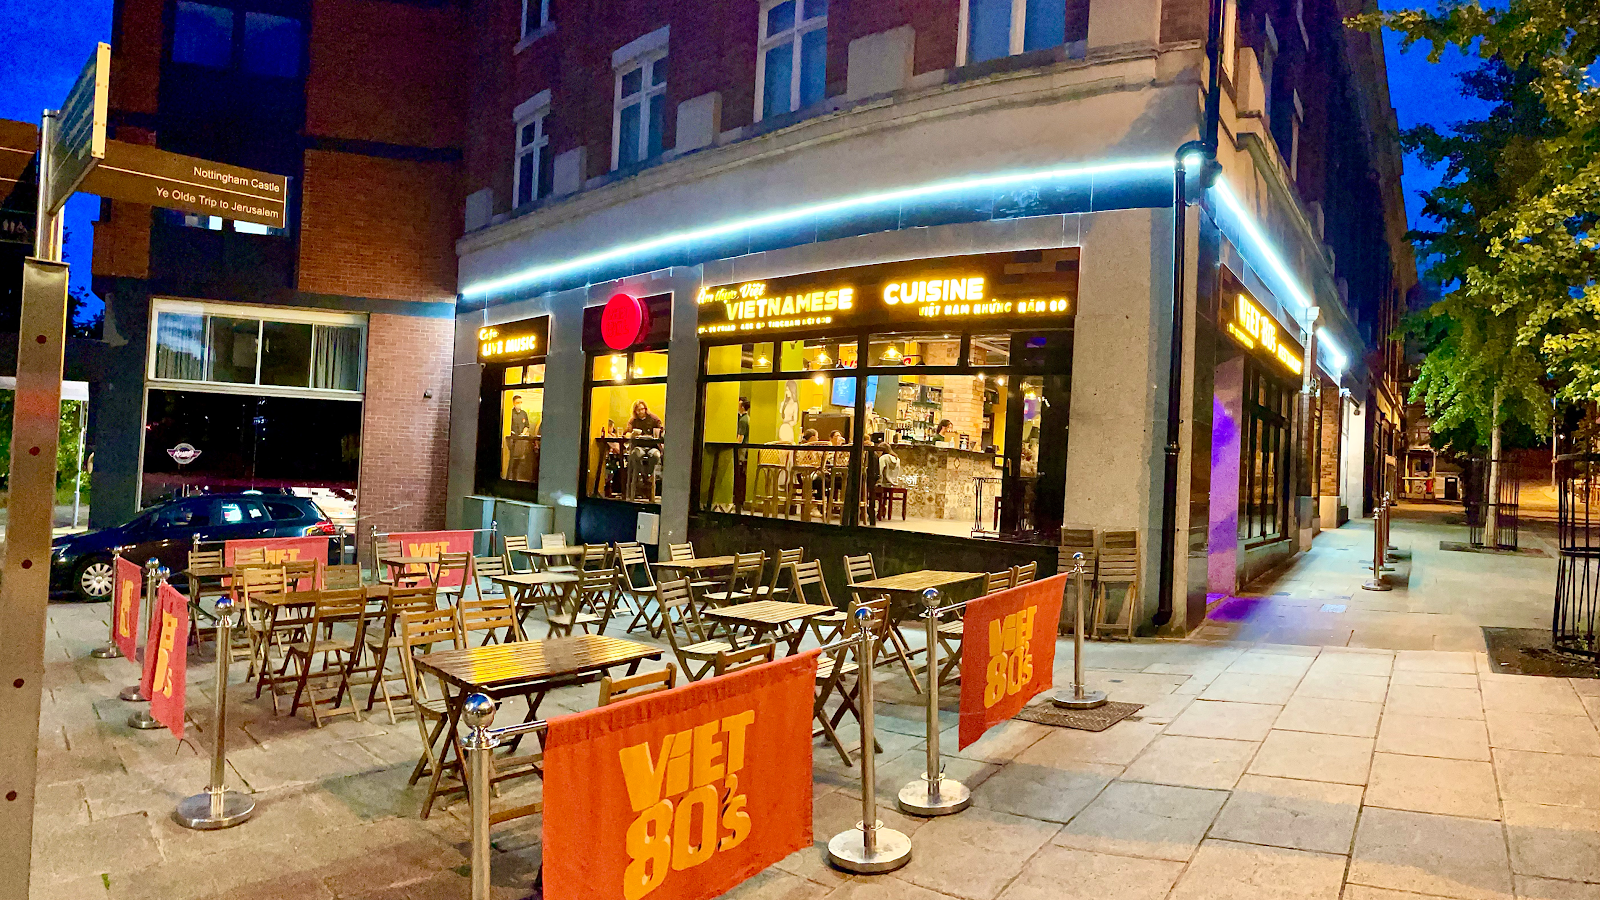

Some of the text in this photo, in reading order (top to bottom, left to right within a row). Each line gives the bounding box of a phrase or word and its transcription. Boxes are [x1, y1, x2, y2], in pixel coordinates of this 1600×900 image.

[194, 166, 280, 192] Nottingham Castle
[156, 187, 279, 218] Ye Olde Trip to Jerusalem
[726, 288, 854, 320] VIETNAMESE
[883, 277, 985, 305] CUISINE
[482, 335, 536, 356] LIVE MUSIC
